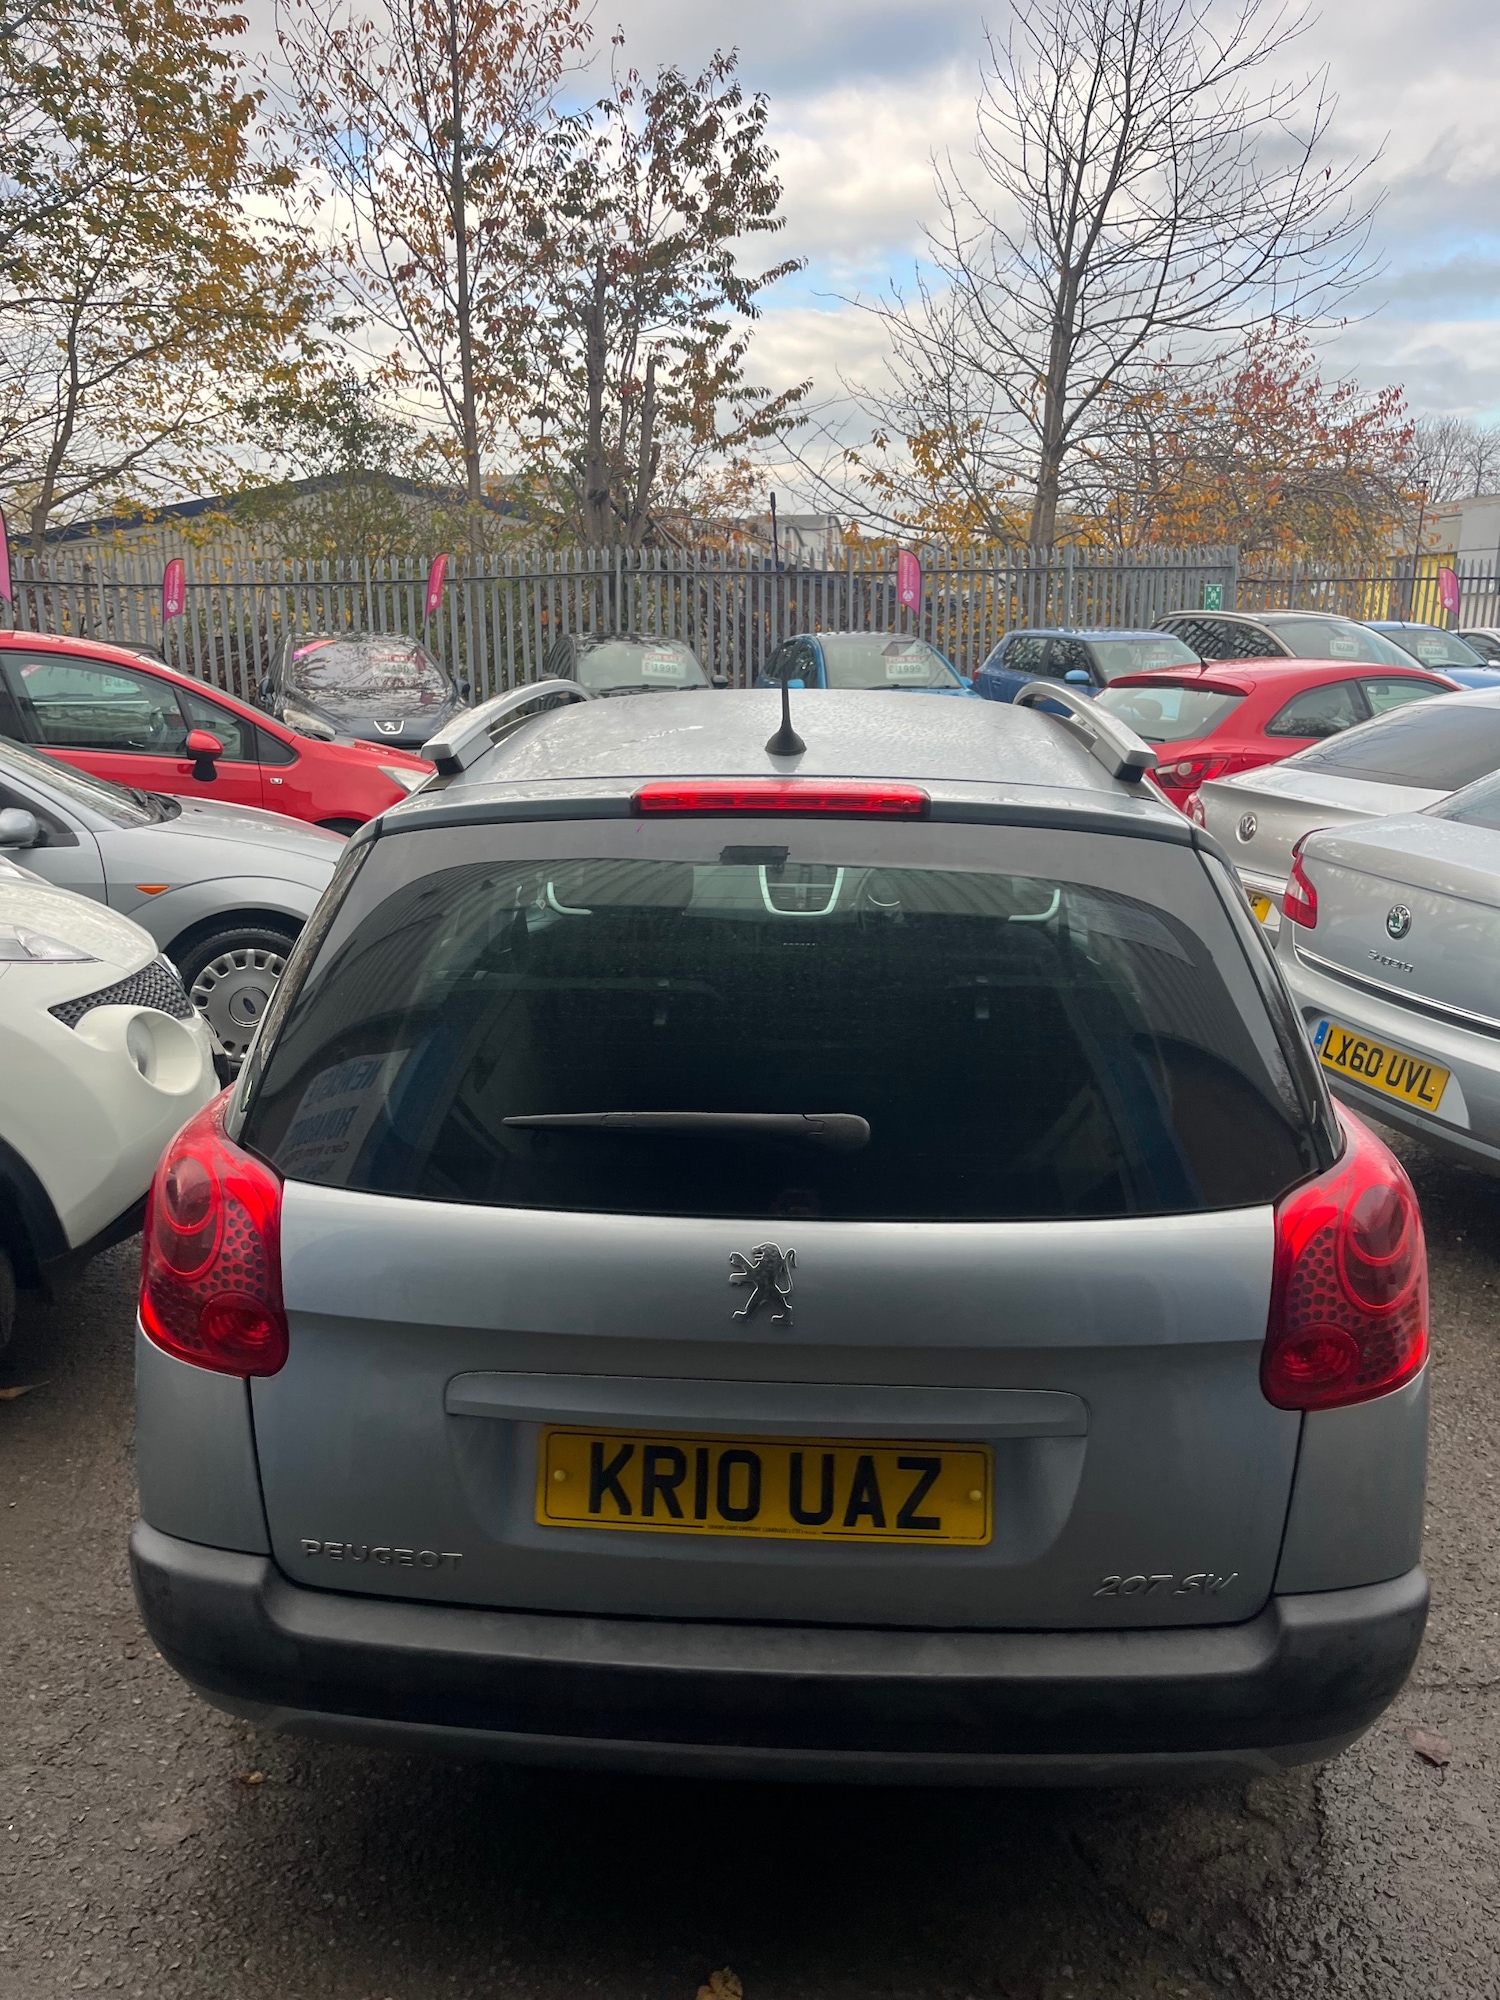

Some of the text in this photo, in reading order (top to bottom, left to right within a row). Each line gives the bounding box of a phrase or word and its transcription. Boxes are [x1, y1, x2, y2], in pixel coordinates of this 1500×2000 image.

[1367, 949, 1413, 973] Superb
[1321, 1029, 1433, 1103] LX60 UVL
[588, 1441, 942, 1530] KR10 UAZ
[300, 1538, 463, 1571] PEUGEOT
[1093, 1573, 1239, 1597] 207 SW
